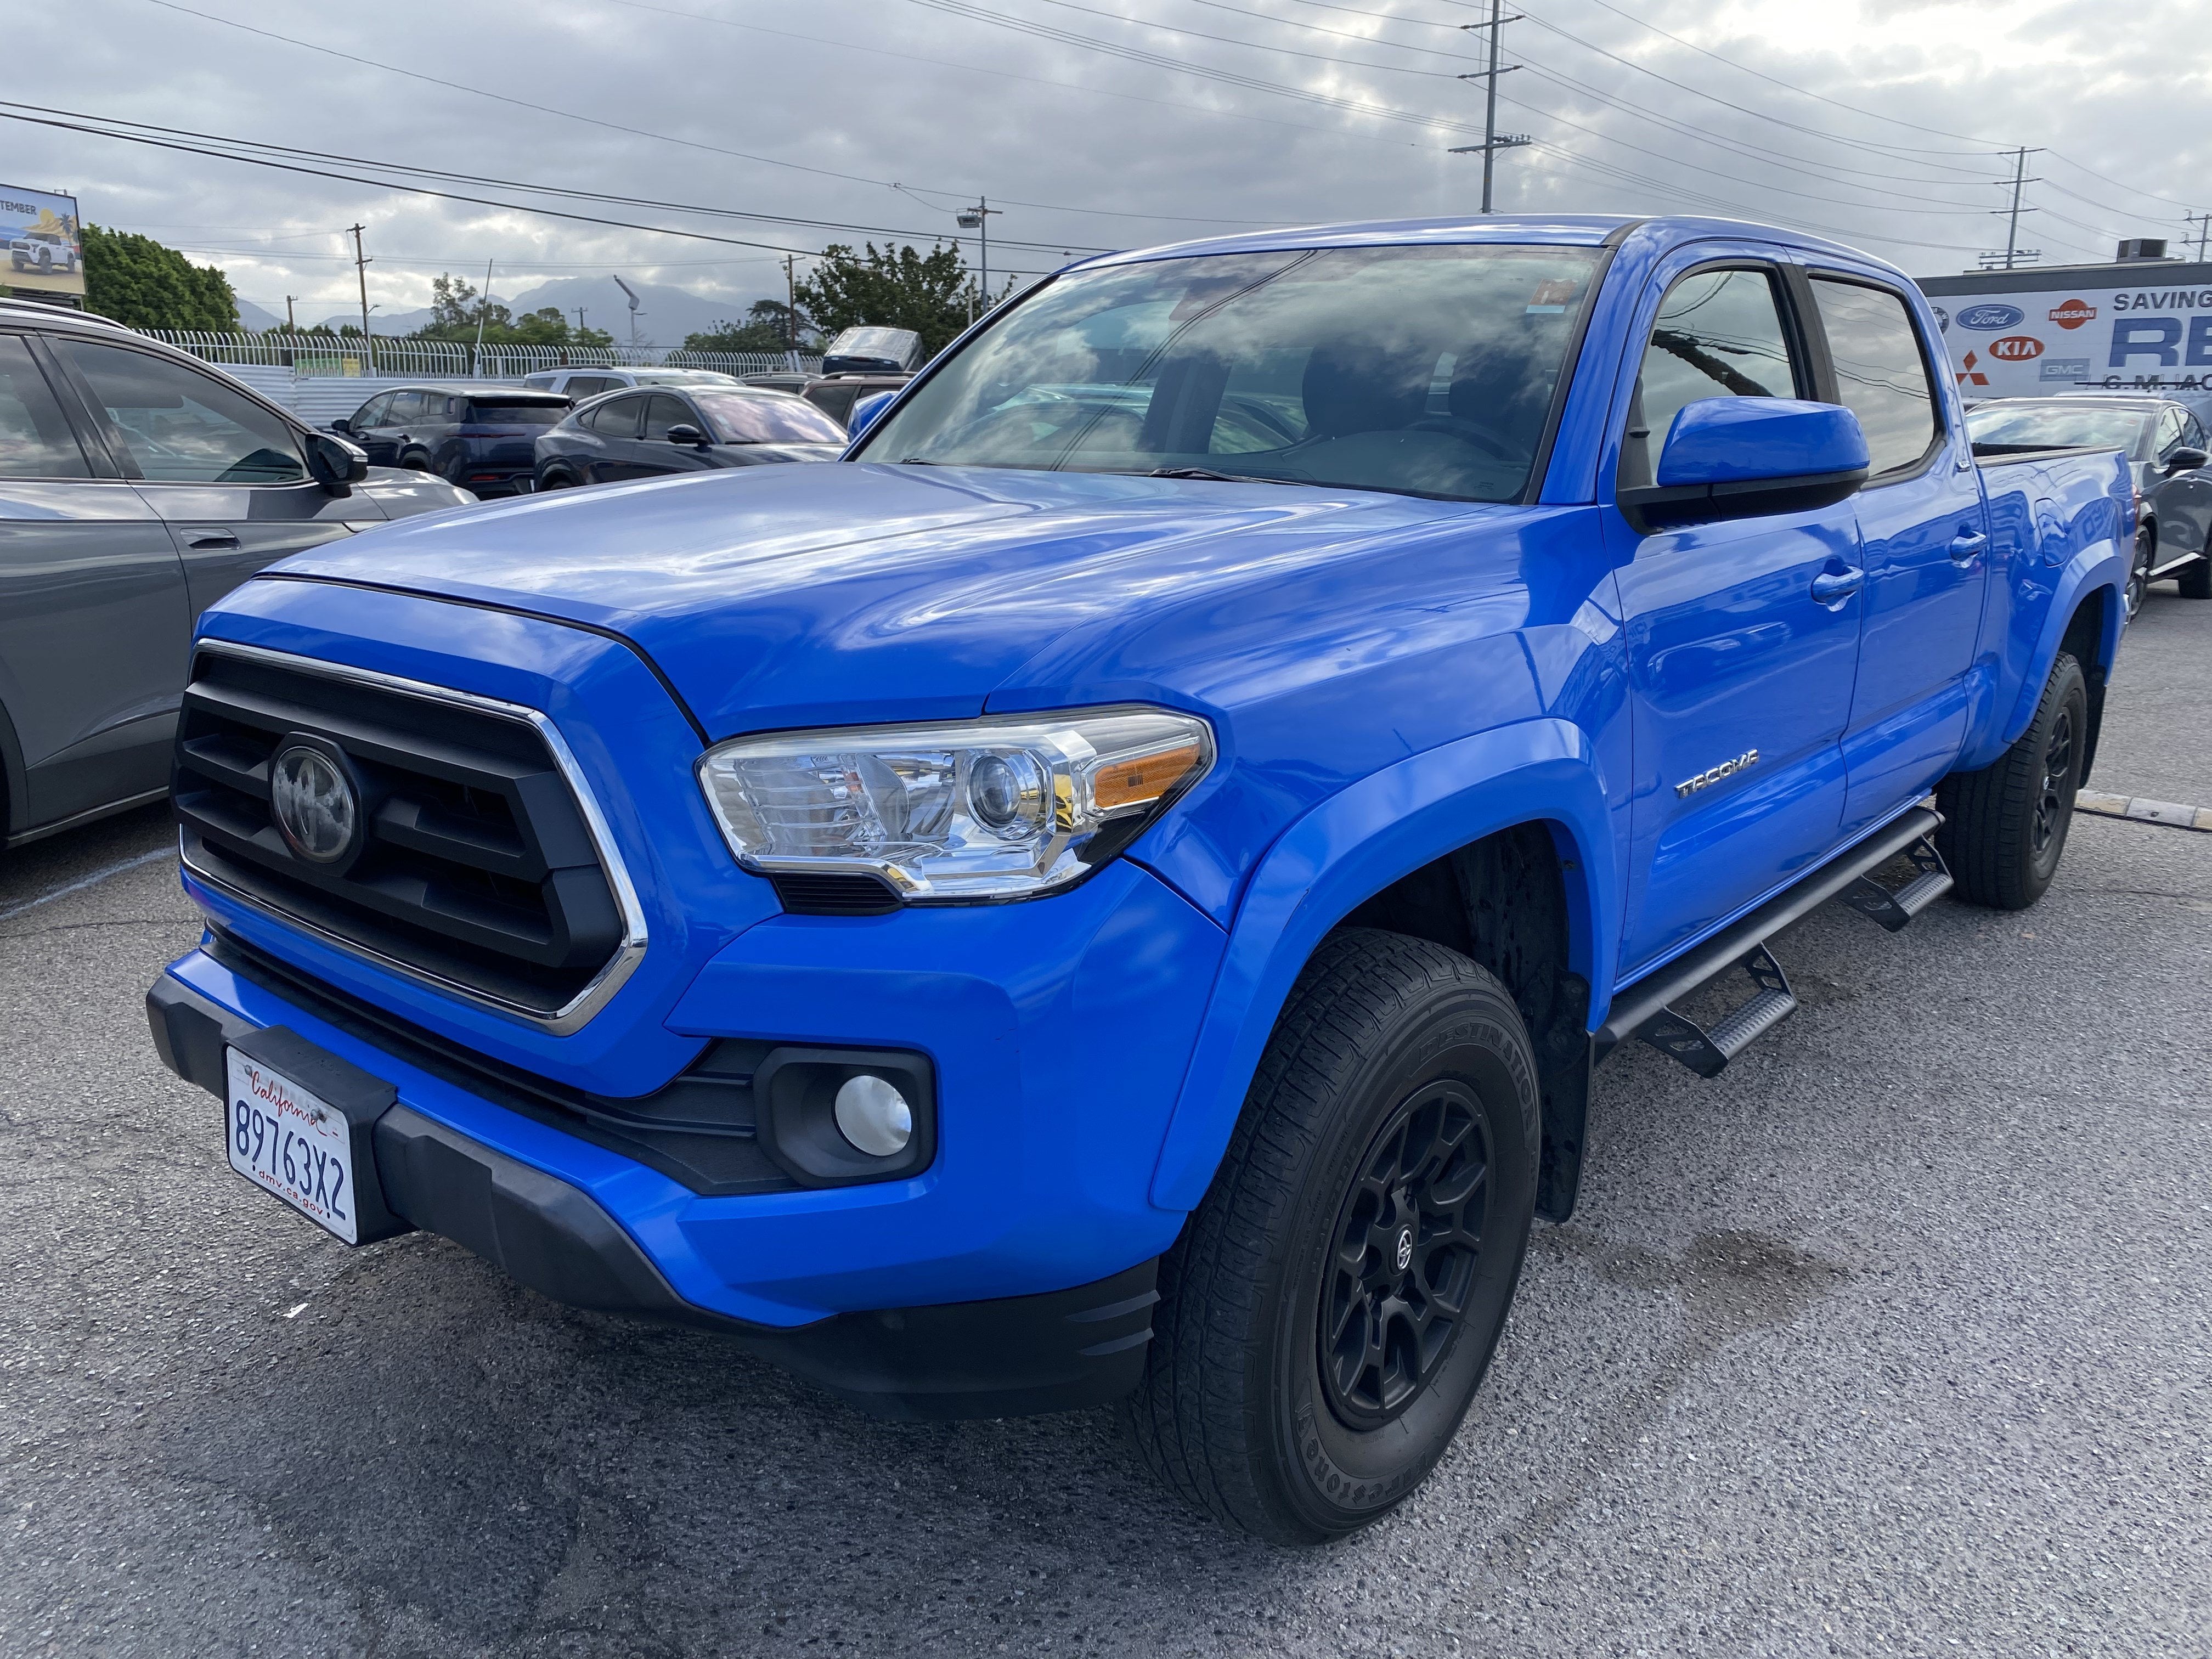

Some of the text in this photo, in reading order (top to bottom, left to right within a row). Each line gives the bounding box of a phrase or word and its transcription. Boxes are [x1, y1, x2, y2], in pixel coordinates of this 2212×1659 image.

[1971, 309, 2009, 325] Ford
[2051, 310, 2095, 319] NISSAN
[1997, 341, 2037, 356] KIA
[2045, 364, 2084, 375] GMC
[1674, 748, 1759, 799] TACOMA
[236, 1099, 346, 1221] 89763X2
[258, 1169, 324, 1216] dmv.ca.gov
